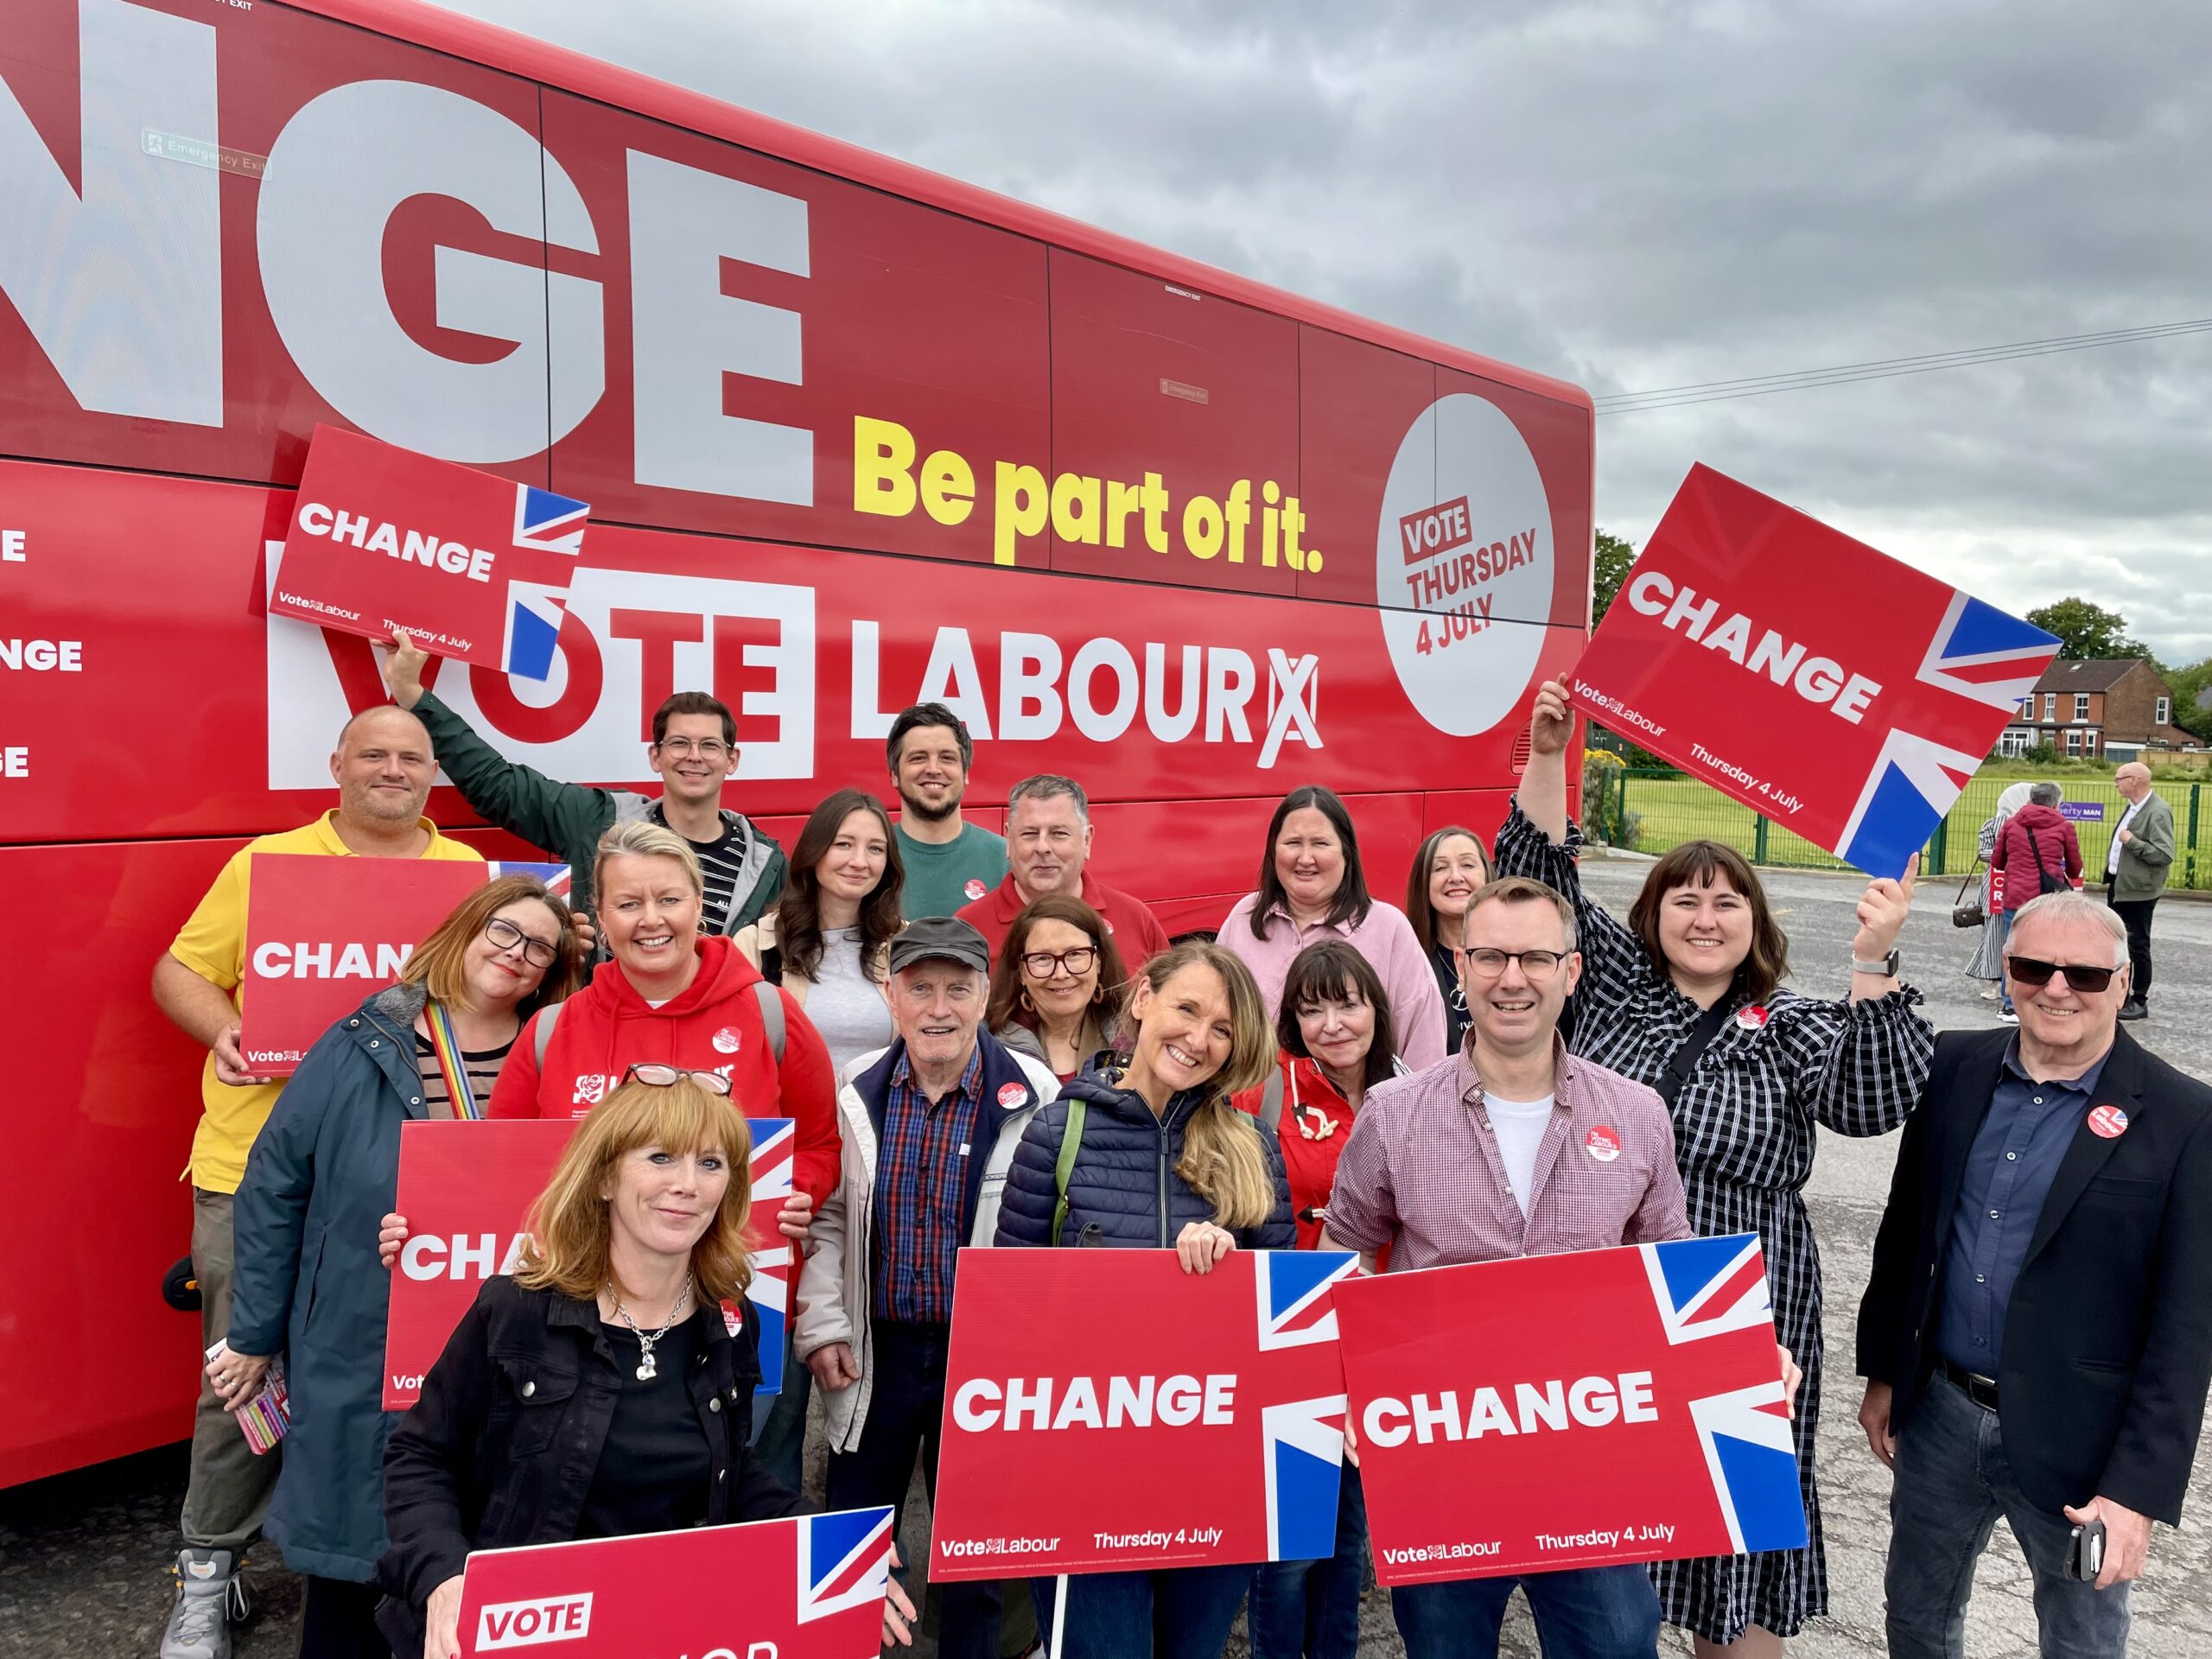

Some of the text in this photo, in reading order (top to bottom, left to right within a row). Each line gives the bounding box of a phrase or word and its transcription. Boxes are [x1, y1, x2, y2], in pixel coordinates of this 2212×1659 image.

[168, 140, 238, 168] Emergency
[854, 415, 1323, 574] Be part of it.
[298, 503, 495, 583] CHANGE
[1403, 505, 1467, 555] VOTE
[1406, 527, 1536, 610] THURSDAY
[279, 591, 361, 621] Vote Labour
[382, 619, 473, 652] Thursday 4 July
[1415, 592, 1494, 656] 4 JULY
[1628, 570, 1882, 725] CHANGE
[850, 619, 1256, 743] LABOUR
[1573, 678, 1667, 738] Vote Labour
[1689, 742, 1805, 816] Thursday 4 July
[247, 1051, 283, 1062] Vote
[952, 1374, 1237, 1433] CHANGE
[1363, 1370, 1659, 1448] CHANGE
[940, 1527, 1224, 1558] Vote Labour Thursday 4 July
[1383, 1545, 1427, 1565] Vote
[1443, 1541, 1502, 1560] Labour
[1535, 1529, 1620, 1550] Thursday
[1623, 1526, 1636, 1541] 4
[1638, 1522, 1675, 1543] July
[484, 1601, 587, 1642] VOTE
